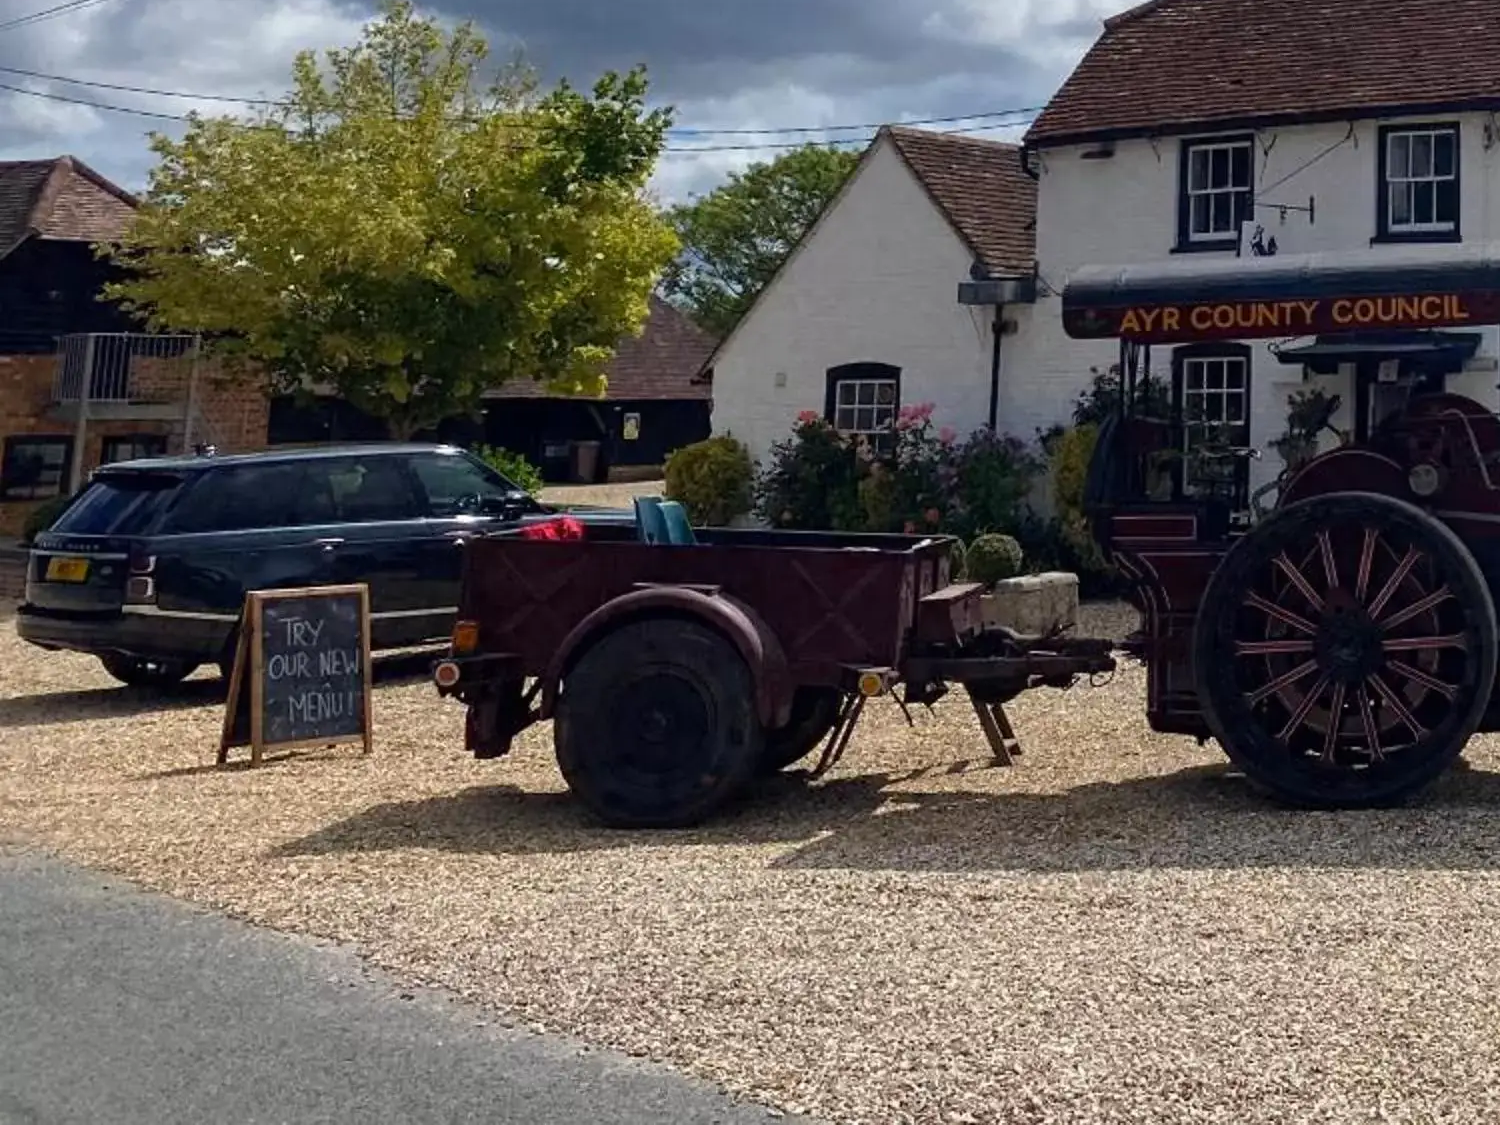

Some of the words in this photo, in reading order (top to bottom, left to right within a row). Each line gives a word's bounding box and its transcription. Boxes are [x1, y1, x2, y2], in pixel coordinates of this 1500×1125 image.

[1120, 306, 1181, 333] AYR
[1191, 301, 1321, 330] COUNTY
[1332, 295, 1470, 324] COUNCIL
[278, 617, 325, 646] TRY
[269, 651, 312, 680] OUR
[319, 648, 359, 677] NEW
